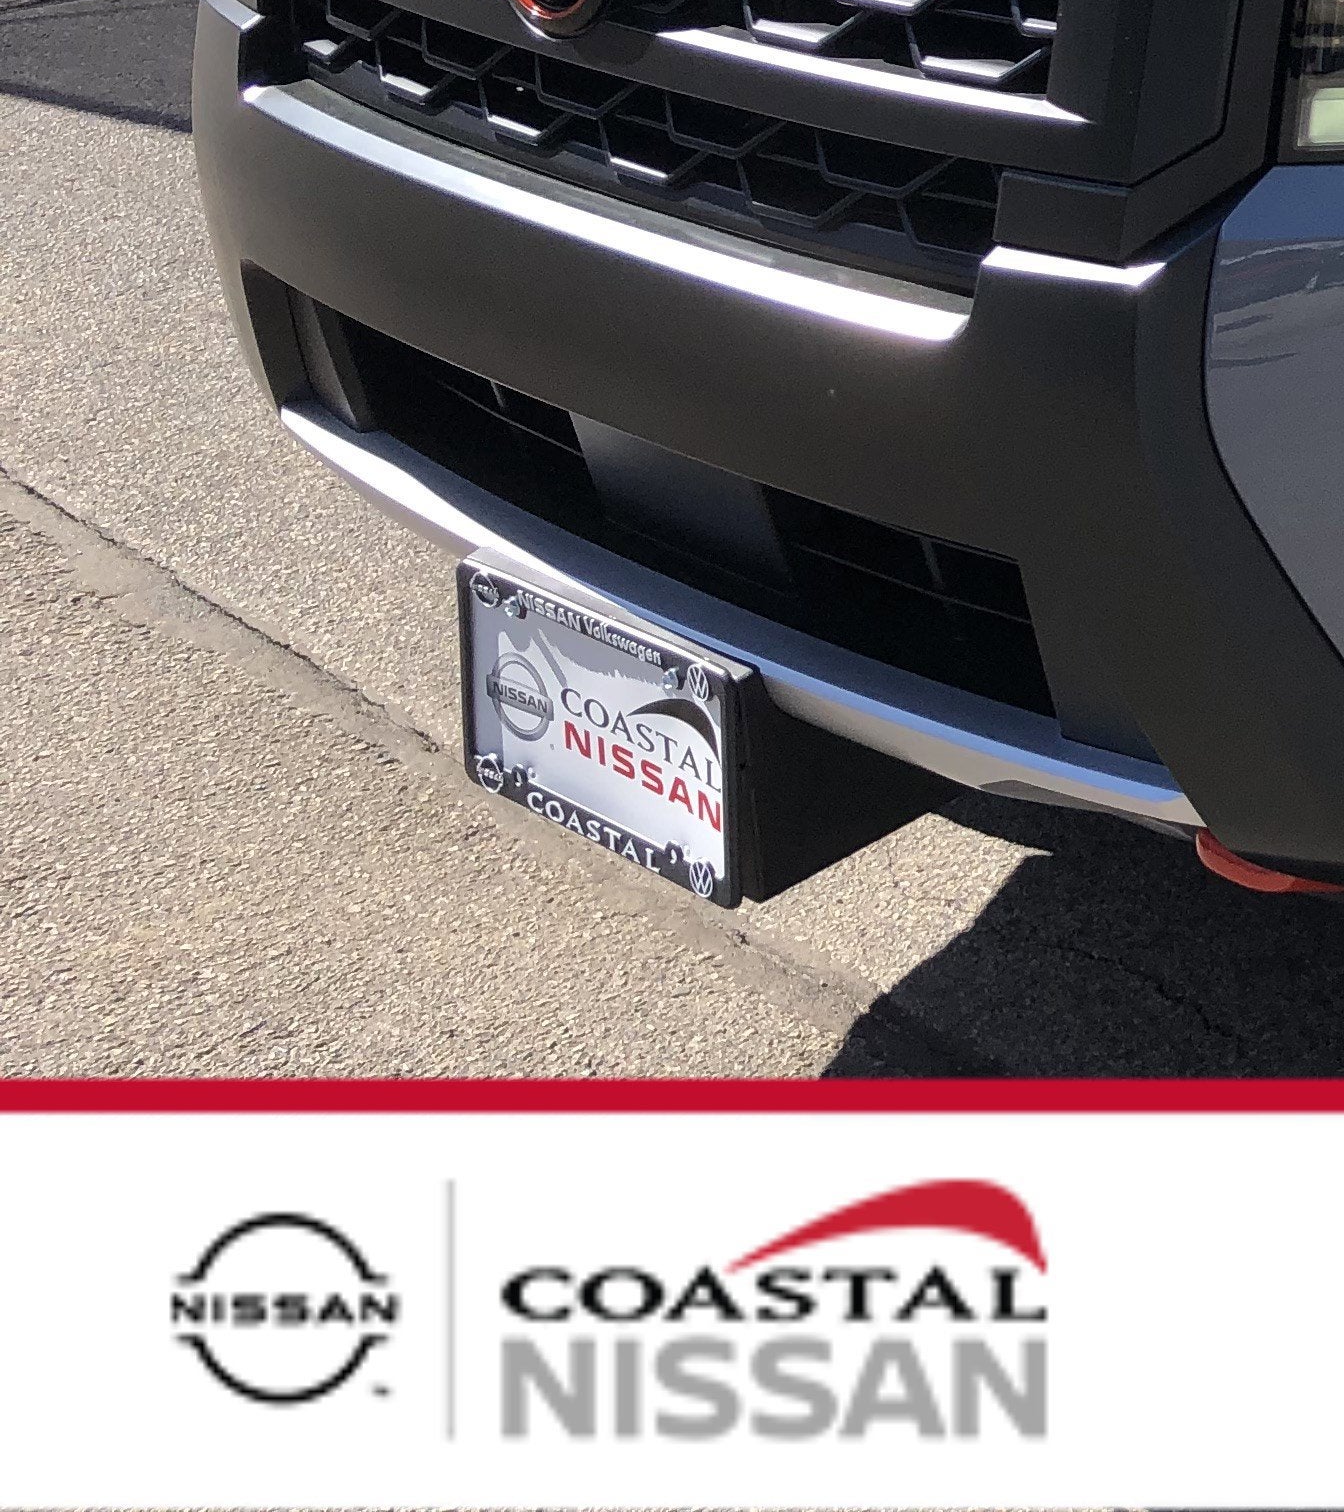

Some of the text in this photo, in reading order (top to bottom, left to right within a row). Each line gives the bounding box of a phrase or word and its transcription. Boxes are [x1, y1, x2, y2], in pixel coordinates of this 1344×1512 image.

[516, 589, 662, 666] NISSAN Volkswagen
[492, 680, 548, 715] NISSAN
[560, 687, 722, 793] COASTAL
[564, 720, 722, 832] NISSAN
[527, 791, 662, 874] COASTAL
